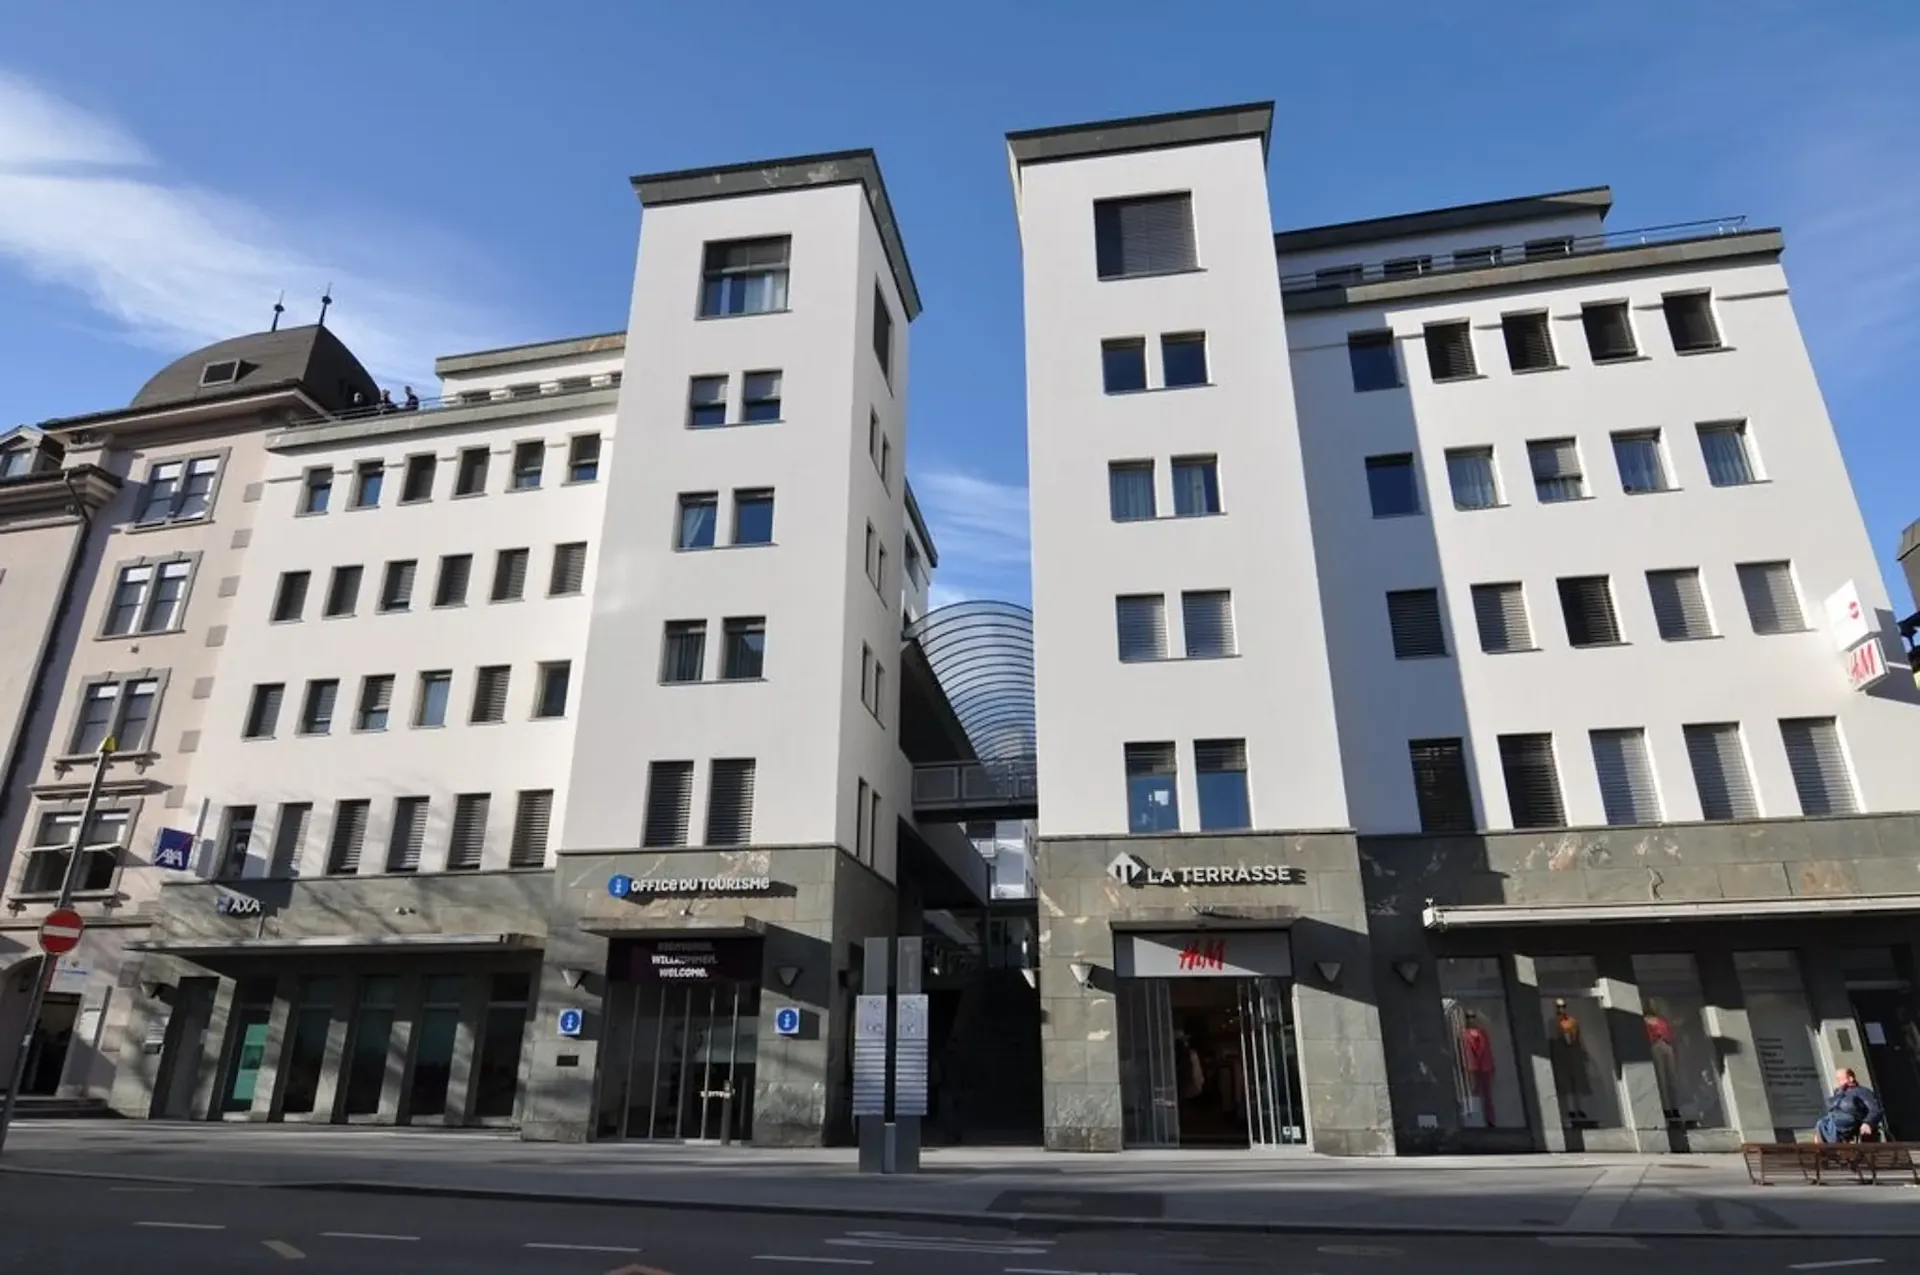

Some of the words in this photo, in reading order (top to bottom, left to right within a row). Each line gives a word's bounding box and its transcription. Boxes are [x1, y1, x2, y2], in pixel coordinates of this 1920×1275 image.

[155, 848, 183, 867] AXA
[1147, 867, 1175, 884] LA
[1179, 864, 1291, 884] TERRASSE
[630, 879, 678, 892] OFFICE
[679, 878, 699, 891] DU
[699, 876, 770, 891] TOURISME
[230, 899, 261, 913] AXA
[1178, 938, 1226, 971] H&M
